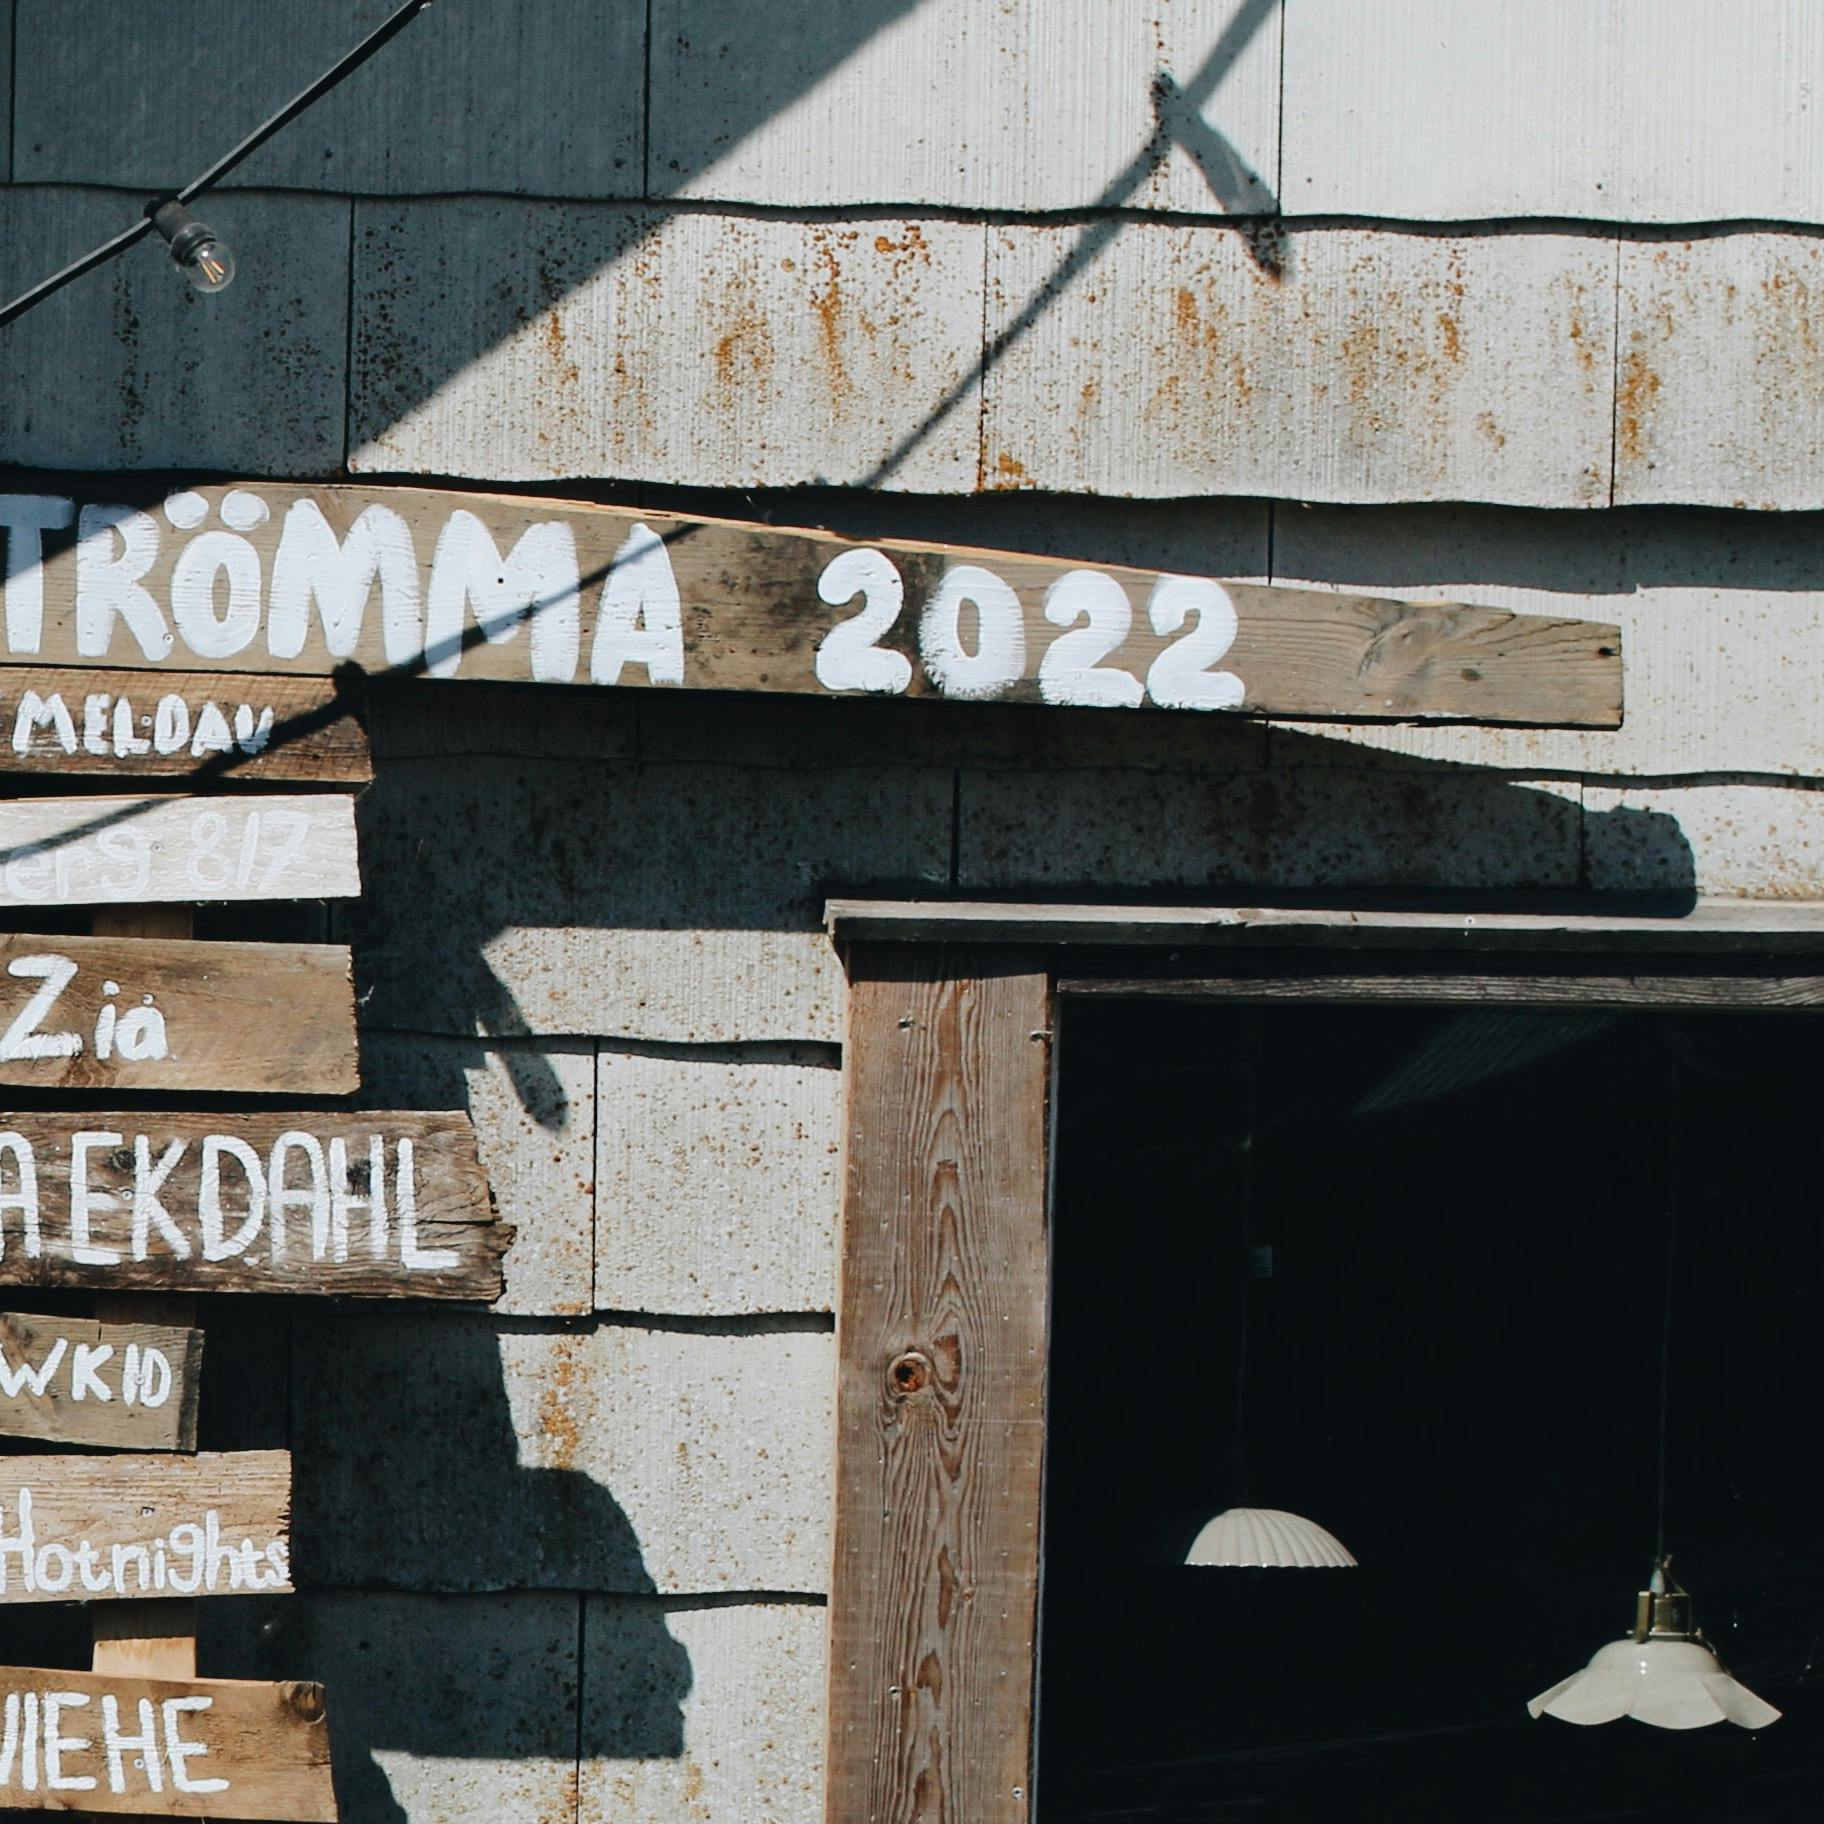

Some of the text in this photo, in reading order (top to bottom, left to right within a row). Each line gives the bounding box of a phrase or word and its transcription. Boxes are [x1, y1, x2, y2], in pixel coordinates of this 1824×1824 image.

[814, 547, 1245, 712] 2022
[184, 809, 314, 893] 8/7
[70, 1129, 461, 1271] EKDAHL
